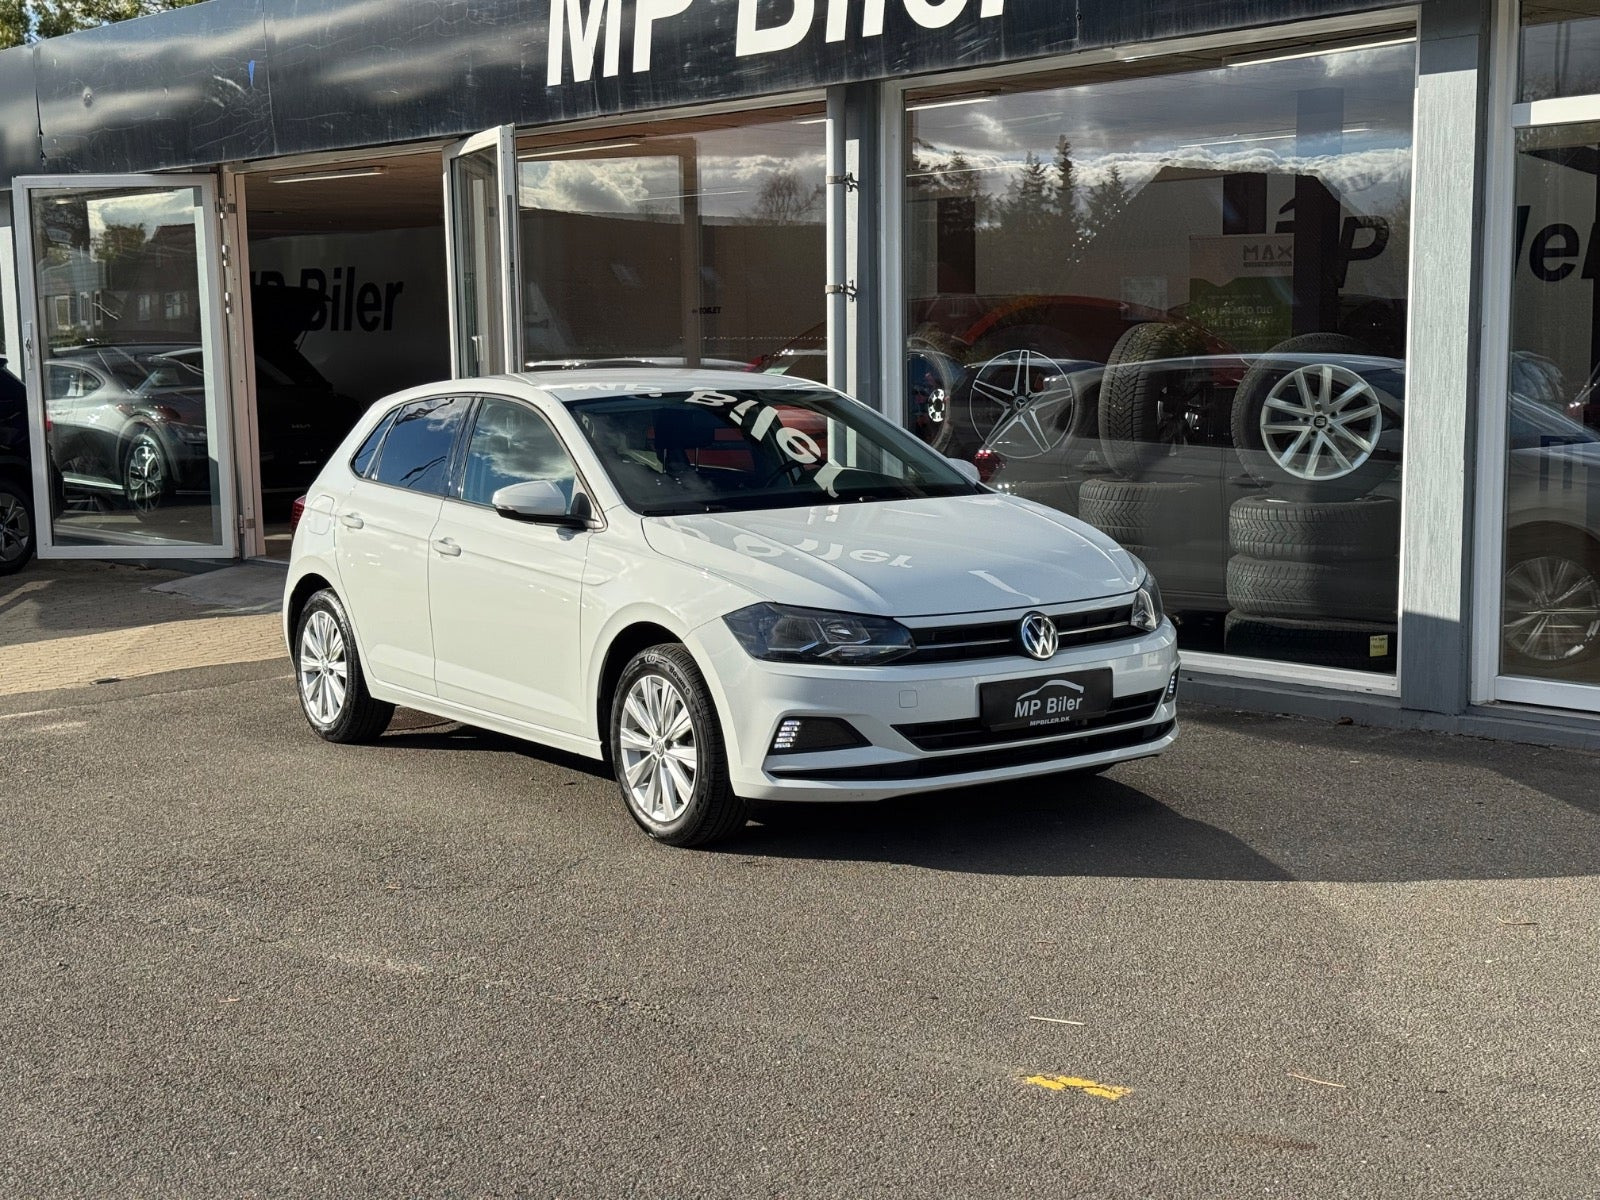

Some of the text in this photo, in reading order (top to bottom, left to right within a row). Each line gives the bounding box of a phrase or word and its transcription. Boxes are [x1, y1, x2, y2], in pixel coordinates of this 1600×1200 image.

[1243, 244, 1293, 262] MAX
[300, 266, 404, 332] Biler
[1014, 696, 1083, 718] MP Biler
[1029, 715, 1070, 727] MPBILER.DK
